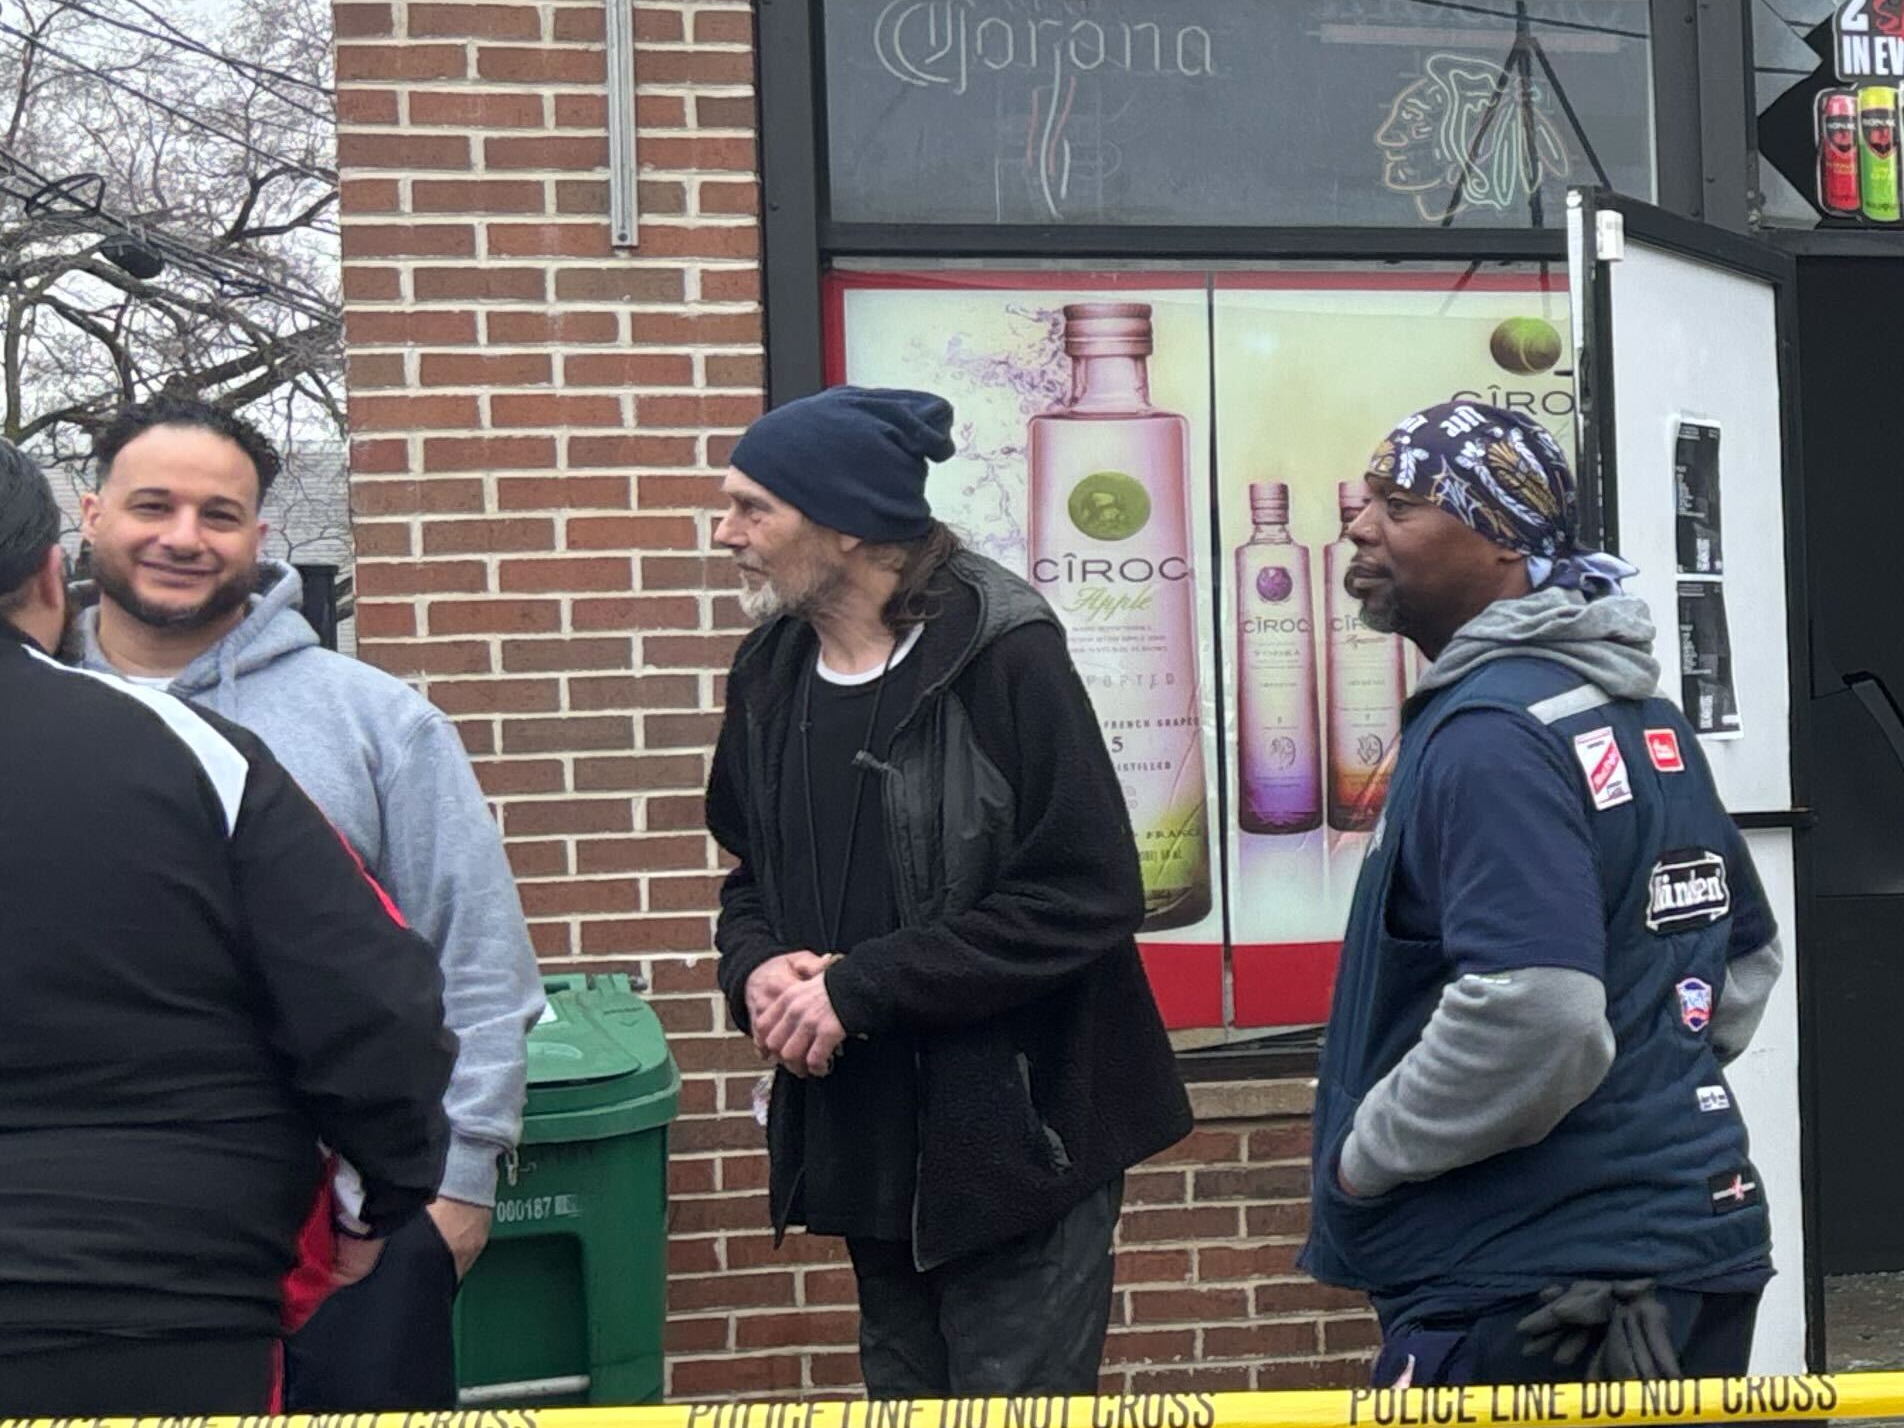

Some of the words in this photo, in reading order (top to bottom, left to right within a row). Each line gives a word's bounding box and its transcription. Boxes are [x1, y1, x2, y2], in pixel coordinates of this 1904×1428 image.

[1842, 36, 1873, 76] IN
[1032, 552, 1189, 584] CÎROC
[1062, 585, 1154, 622] Apple
[1243, 616, 1312, 634] CÎROC
[1111, 736, 1124, 754] 5
[1349, 1387, 1477, 1428] POLICE
[1490, 1385, 1566, 1425] LINE
[1580, 1383, 1626, 1421] DO
[1642, 1380, 1704, 1420] NOT
[1722, 1373, 1838, 1417] CROSS
